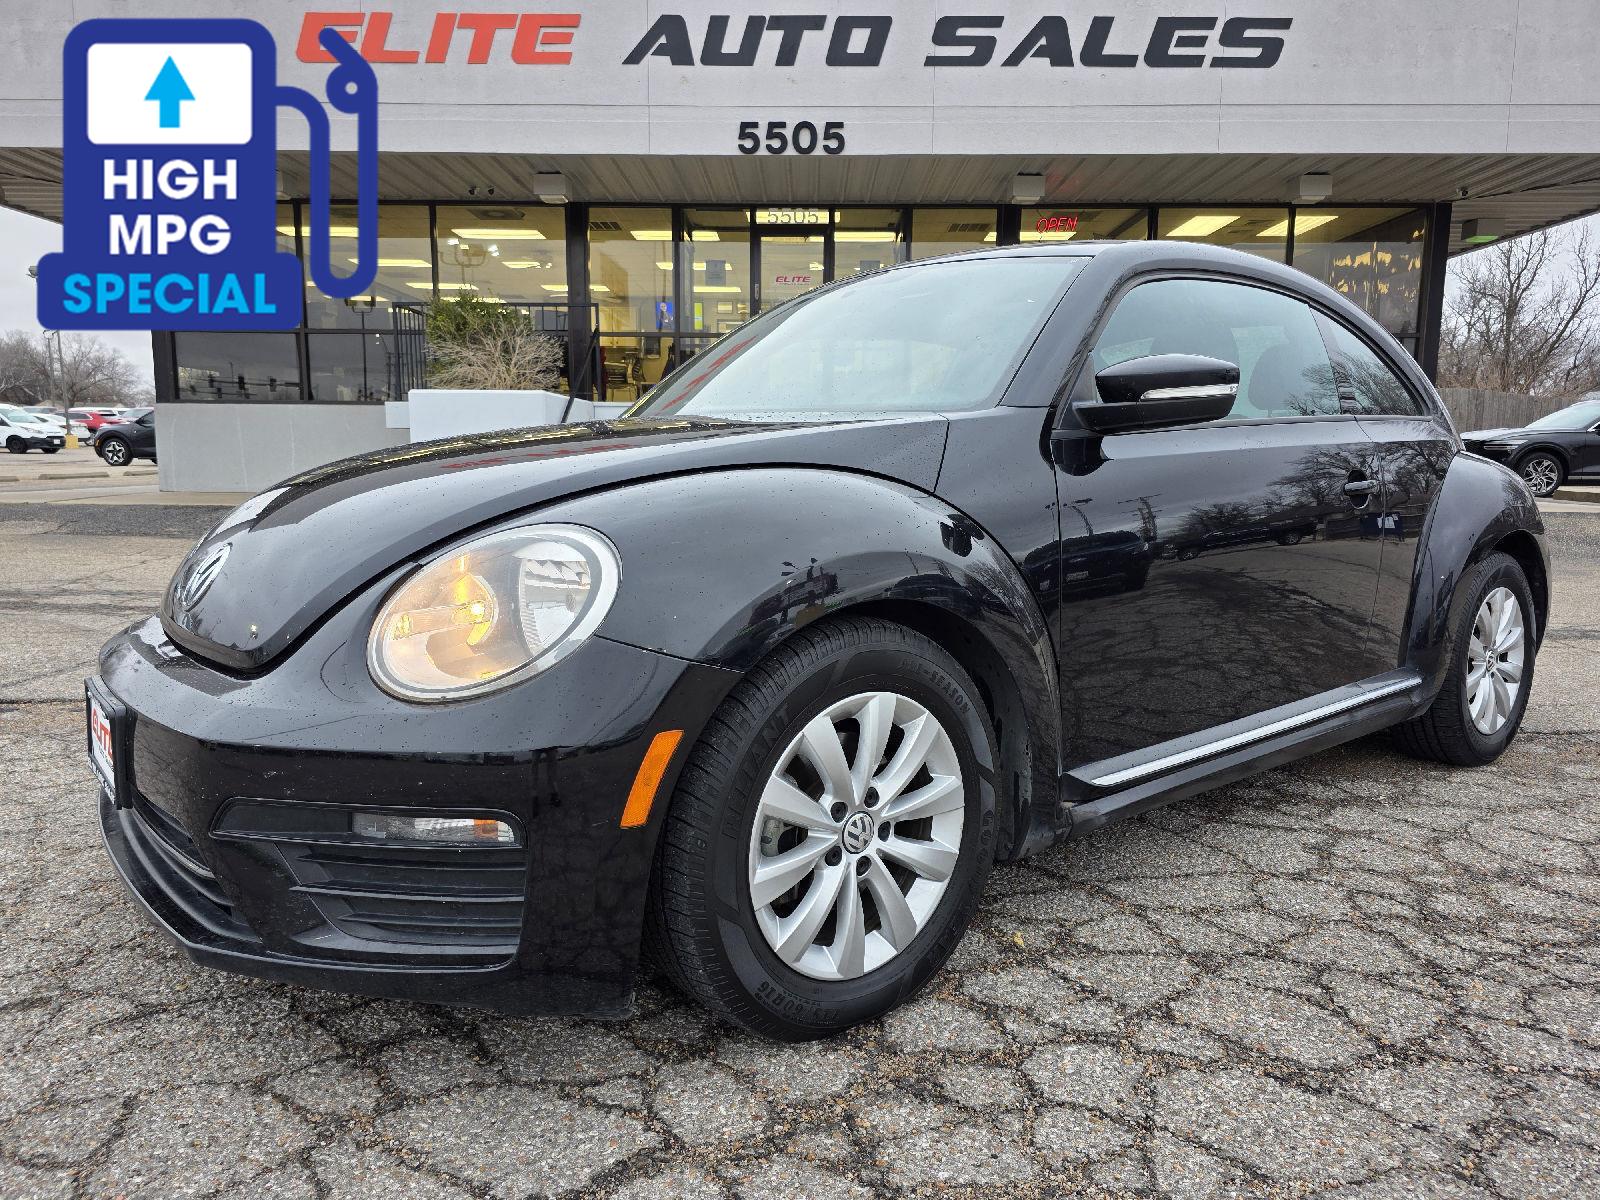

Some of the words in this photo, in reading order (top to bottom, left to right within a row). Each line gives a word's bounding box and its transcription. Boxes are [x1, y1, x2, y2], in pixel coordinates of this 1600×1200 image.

[296, 12, 581, 65] ELITE
[622, 15, 892, 67] AUTO
[924, 16, 1293, 69] SALES
[738, 121, 846, 155] 5505
[767, 208, 819, 223] 5505
[1036, 216, 1078, 233] OPEN
[775, 275, 812, 283] ELITE
